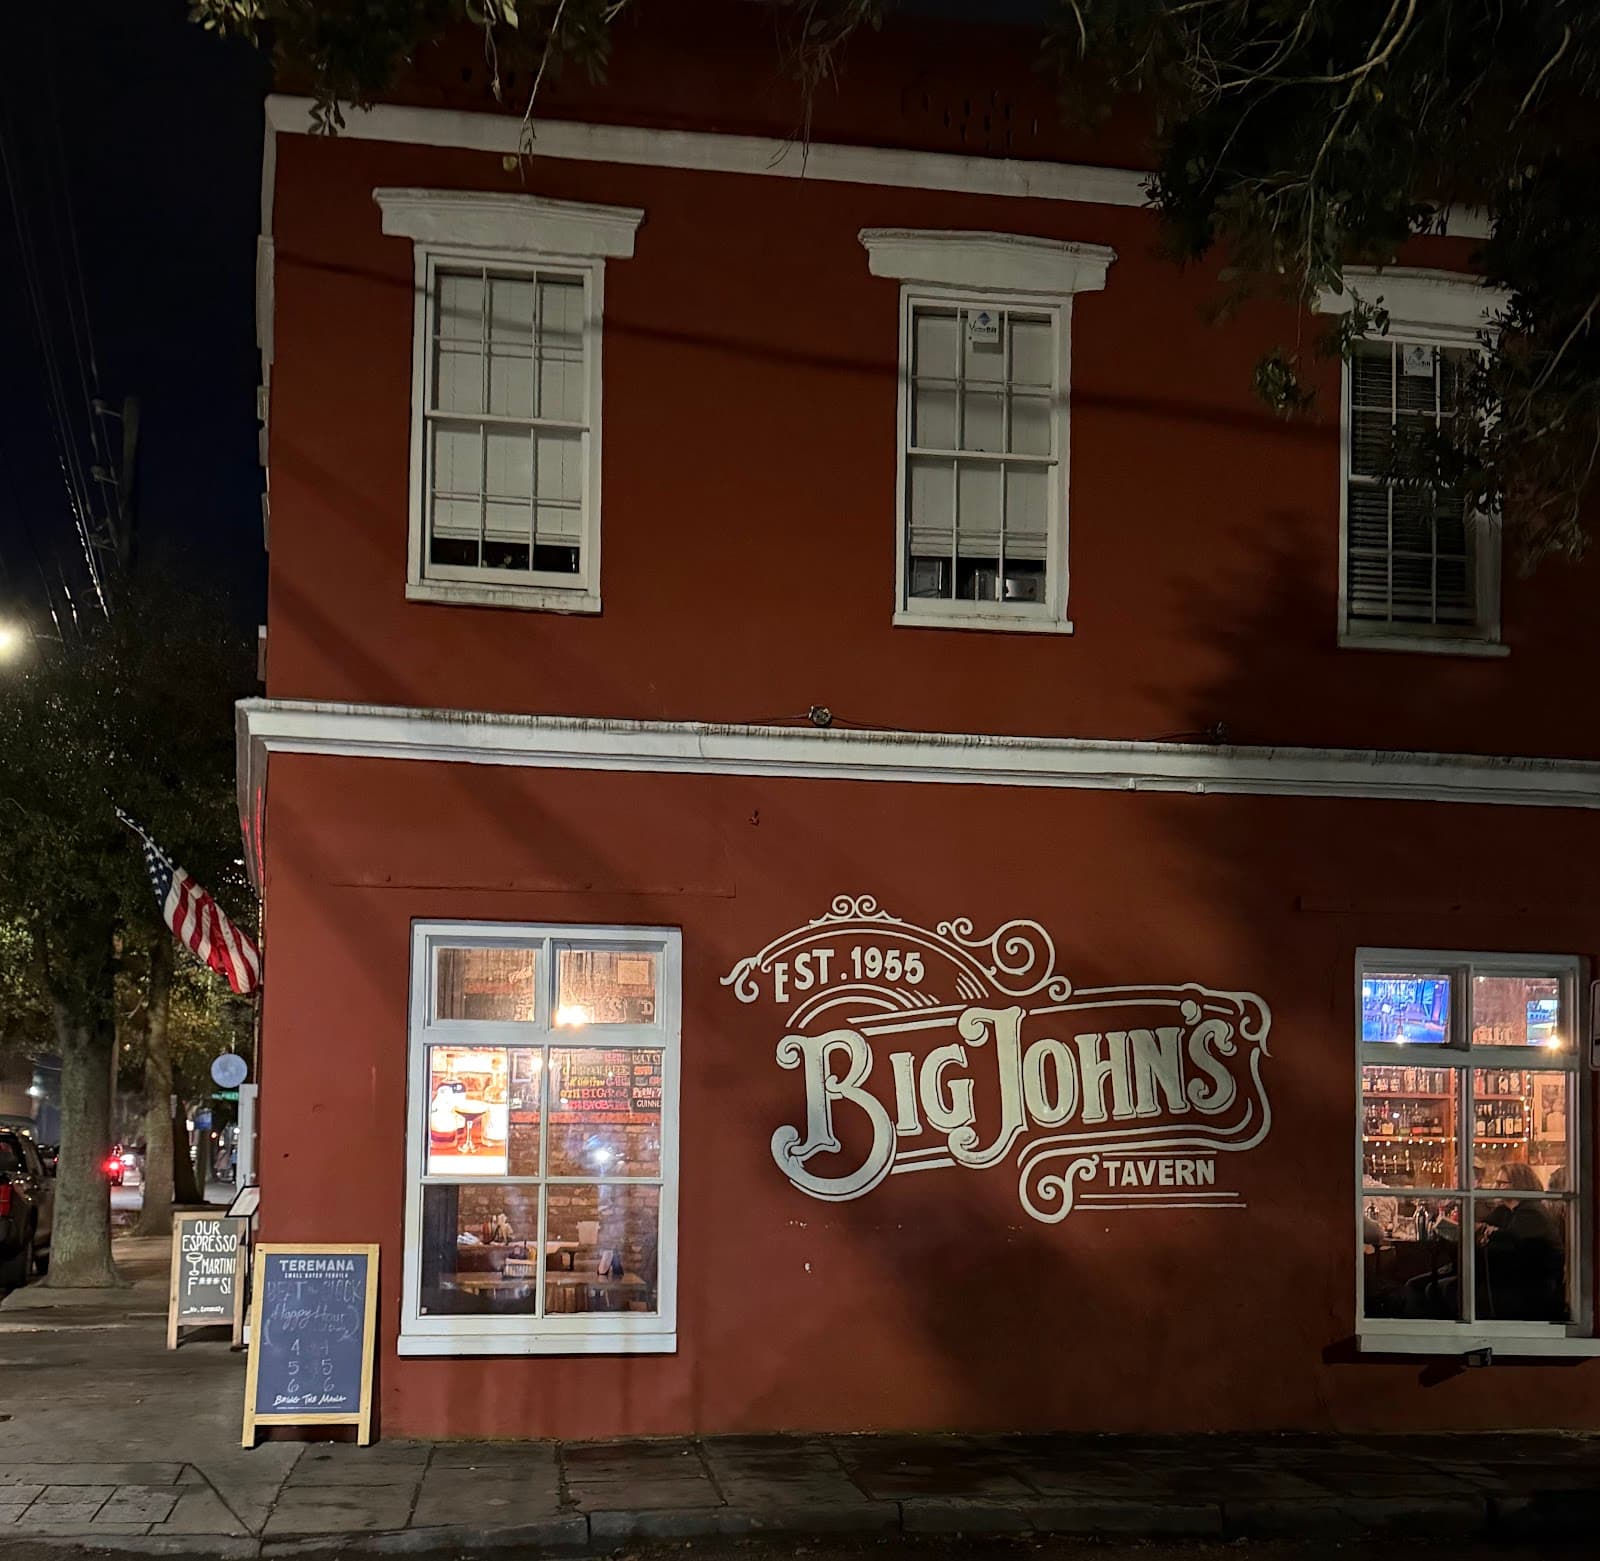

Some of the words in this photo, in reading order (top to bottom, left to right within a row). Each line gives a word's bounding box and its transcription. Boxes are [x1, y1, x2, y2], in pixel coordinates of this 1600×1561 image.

[850, 946, 925, 985] 1955
[636, 1099, 662, 1108] GUINNE
[770, 1028, 975, 1202] BIG
[946, 1005, 1238, 1170] JOHN'S
[1102, 1160, 1216, 1187] TAVERN
[195, 1220, 220, 1235] OUR
[182, 1234, 237, 1252] ESPRESSO
[201, 1257, 237, 1275] MARTINI
[279, 1259, 355, 1272] TEREMANA
[287, 1360, 300, 1375] 5
[321, 1358, 333, 1376] 5
[287, 1378, 300, 1393] 6
[322, 1376, 335, 1392] 6
